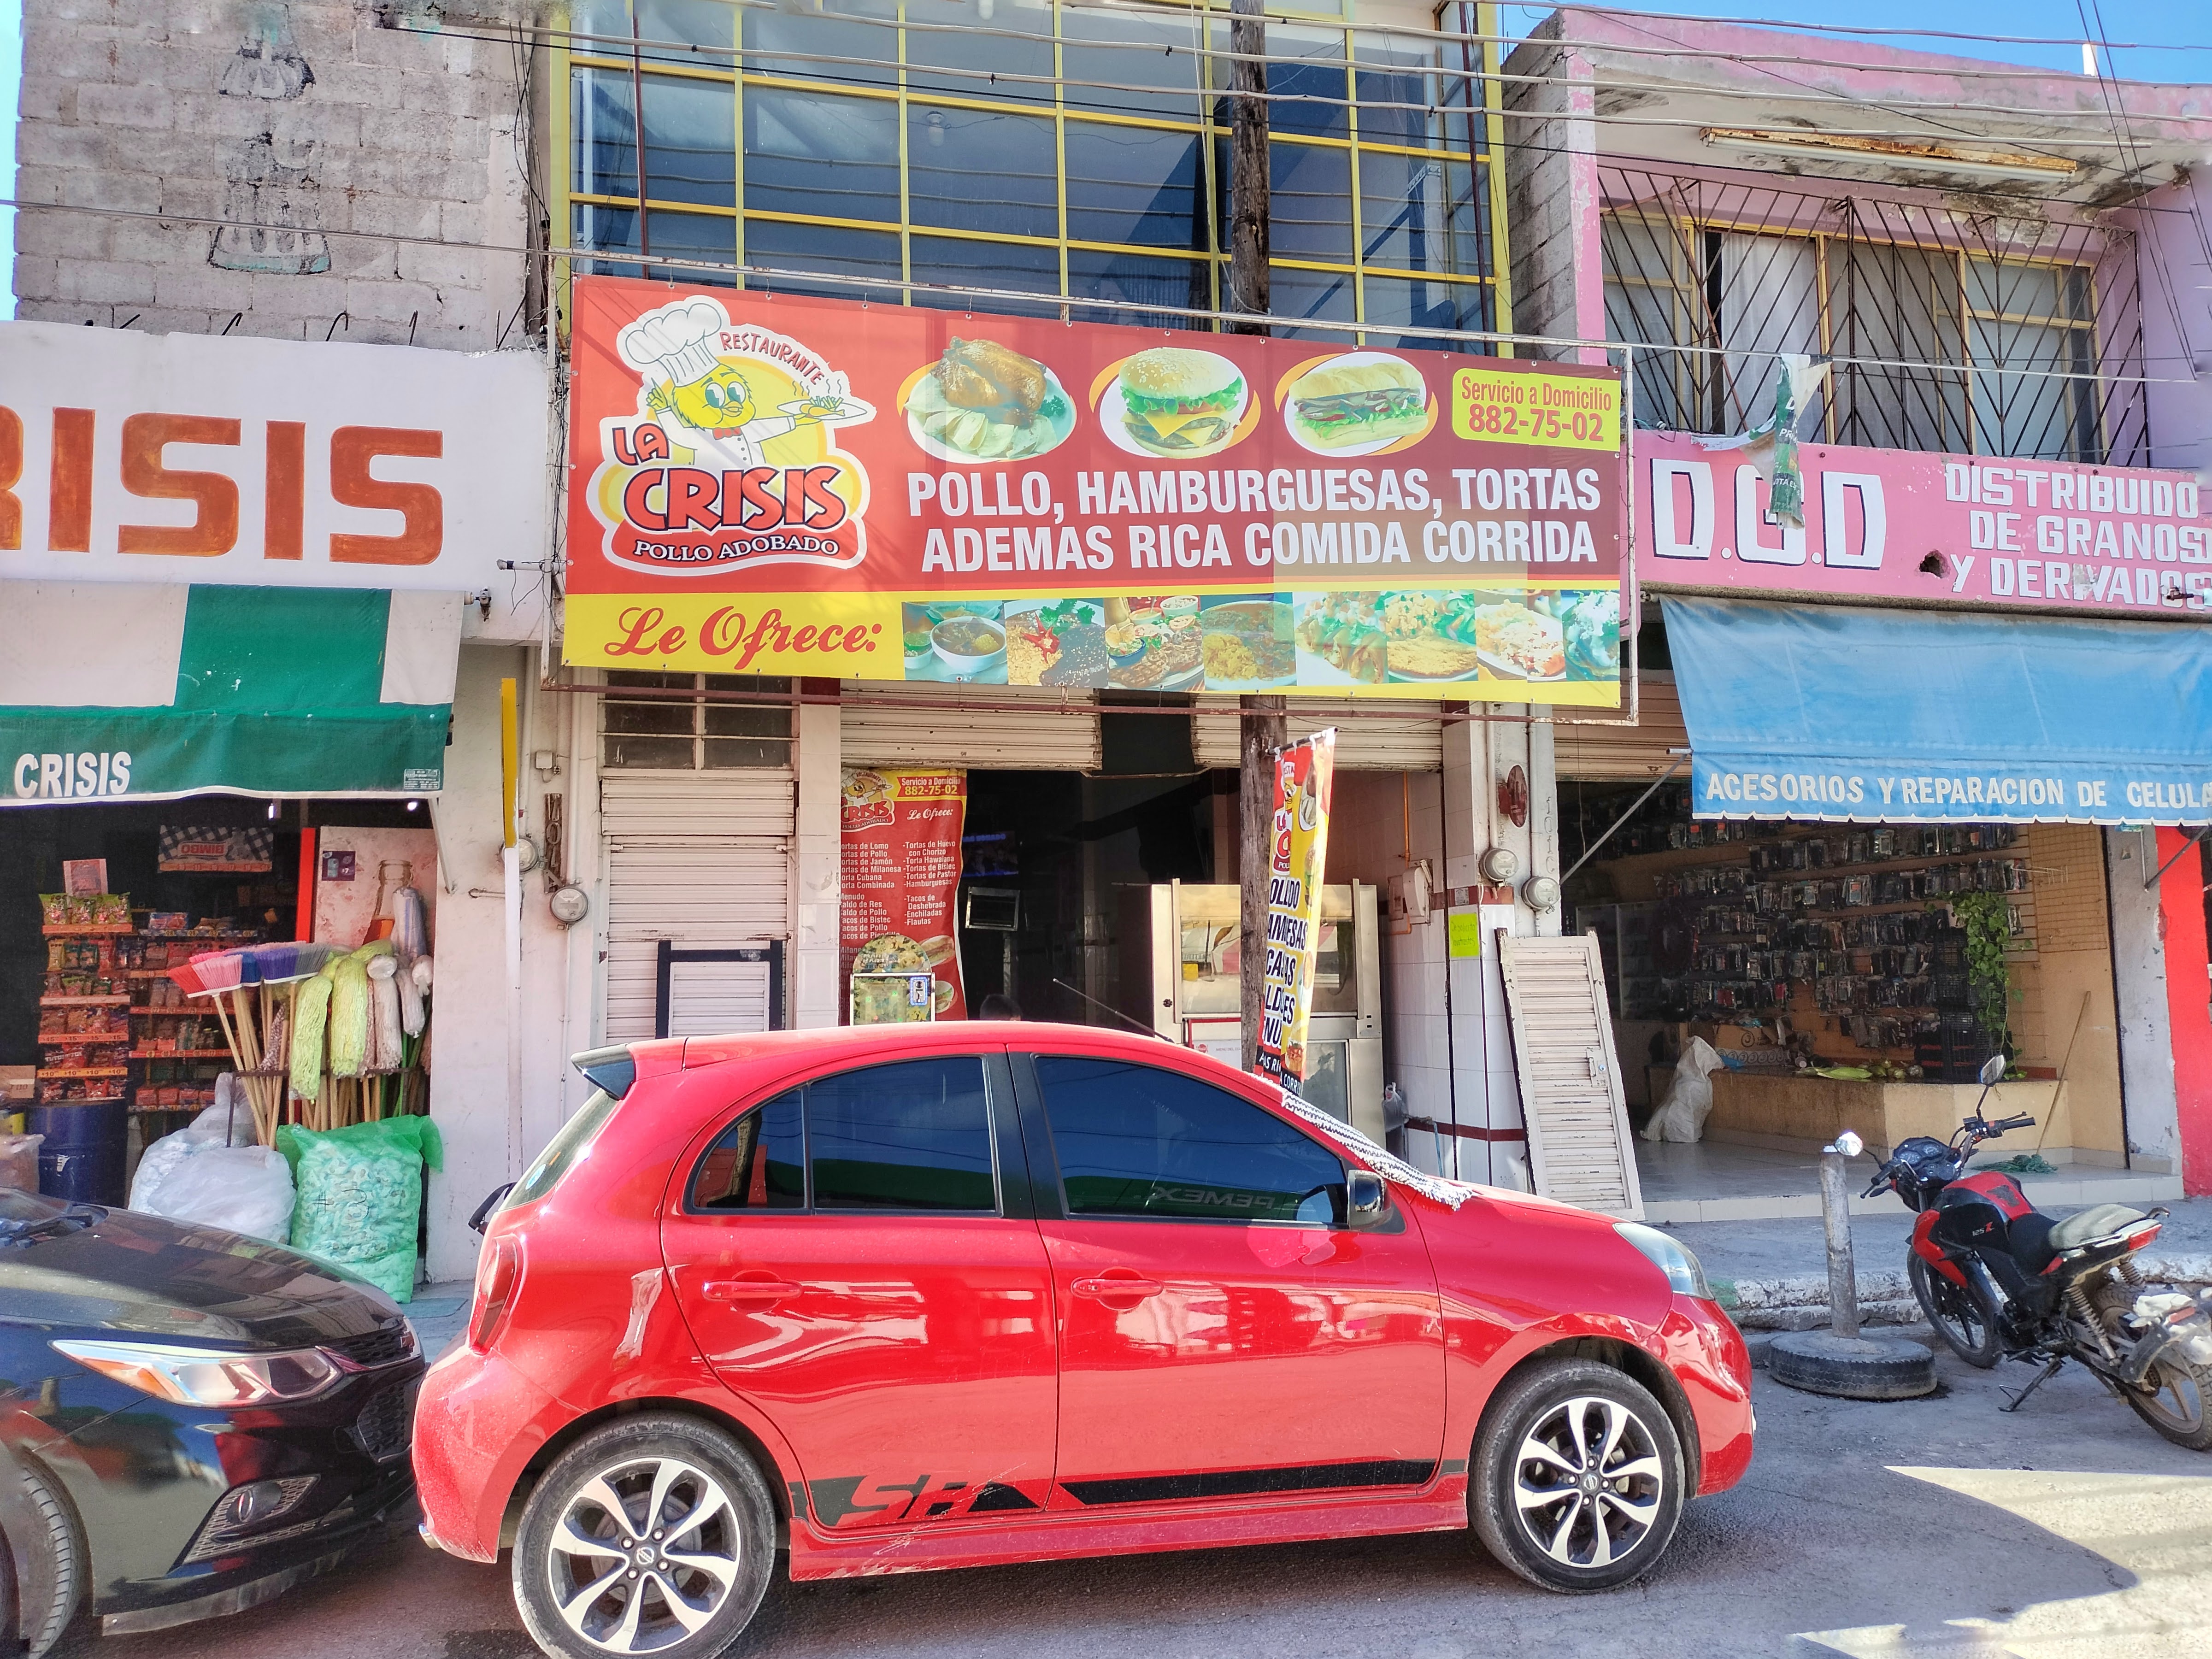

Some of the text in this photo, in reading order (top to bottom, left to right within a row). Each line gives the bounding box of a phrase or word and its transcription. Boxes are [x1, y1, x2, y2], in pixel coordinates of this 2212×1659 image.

[720, 331, 825, 385] RESTAURANTE
[1461, 376, 1612, 412] Servicio a Domicilio
[1468, 403, 1604, 442] 882-75-02
[612, 423, 670, 466] LA
[0, 405, 443, 565] ISIS
[624, 465, 847, 531] CRISIS
[907, 468, 1600, 524] POLLO, HAMBURGUESAS, TORTAS
[1945, 463, 2199, 518] DISTRIBUIDO
[634, 535, 840, 561] POLLO ADOBADO
[922, 521, 1598, 572] ADEMAS RICA COMIDA CORRIDA
[1970, 510, 2212, 564] DE GRANOS
[1950, 554, 1975, 592] Y
[604, 606, 882, 670] Le Ofrece:
[14, 751, 132, 799] CRISIS
[902, 777, 927, 786] Servicio
[934, 777, 961, 785] Domicilio
[905, 785, 957, 795] 882-75-02
[1706, 773, 1864, 804] ACESORIOS
[1877, 777, 1894, 804] Y
[1904, 777, 2064, 805] REPARACION
[2077, 781, 2106, 806] DE
[841, 800, 889, 822] CRISIS
[861, 818, 888, 827] ADOBADO
[907, 808, 953, 821] Le Ofrece:
[908, 900, 946, 910] Deshebrada
